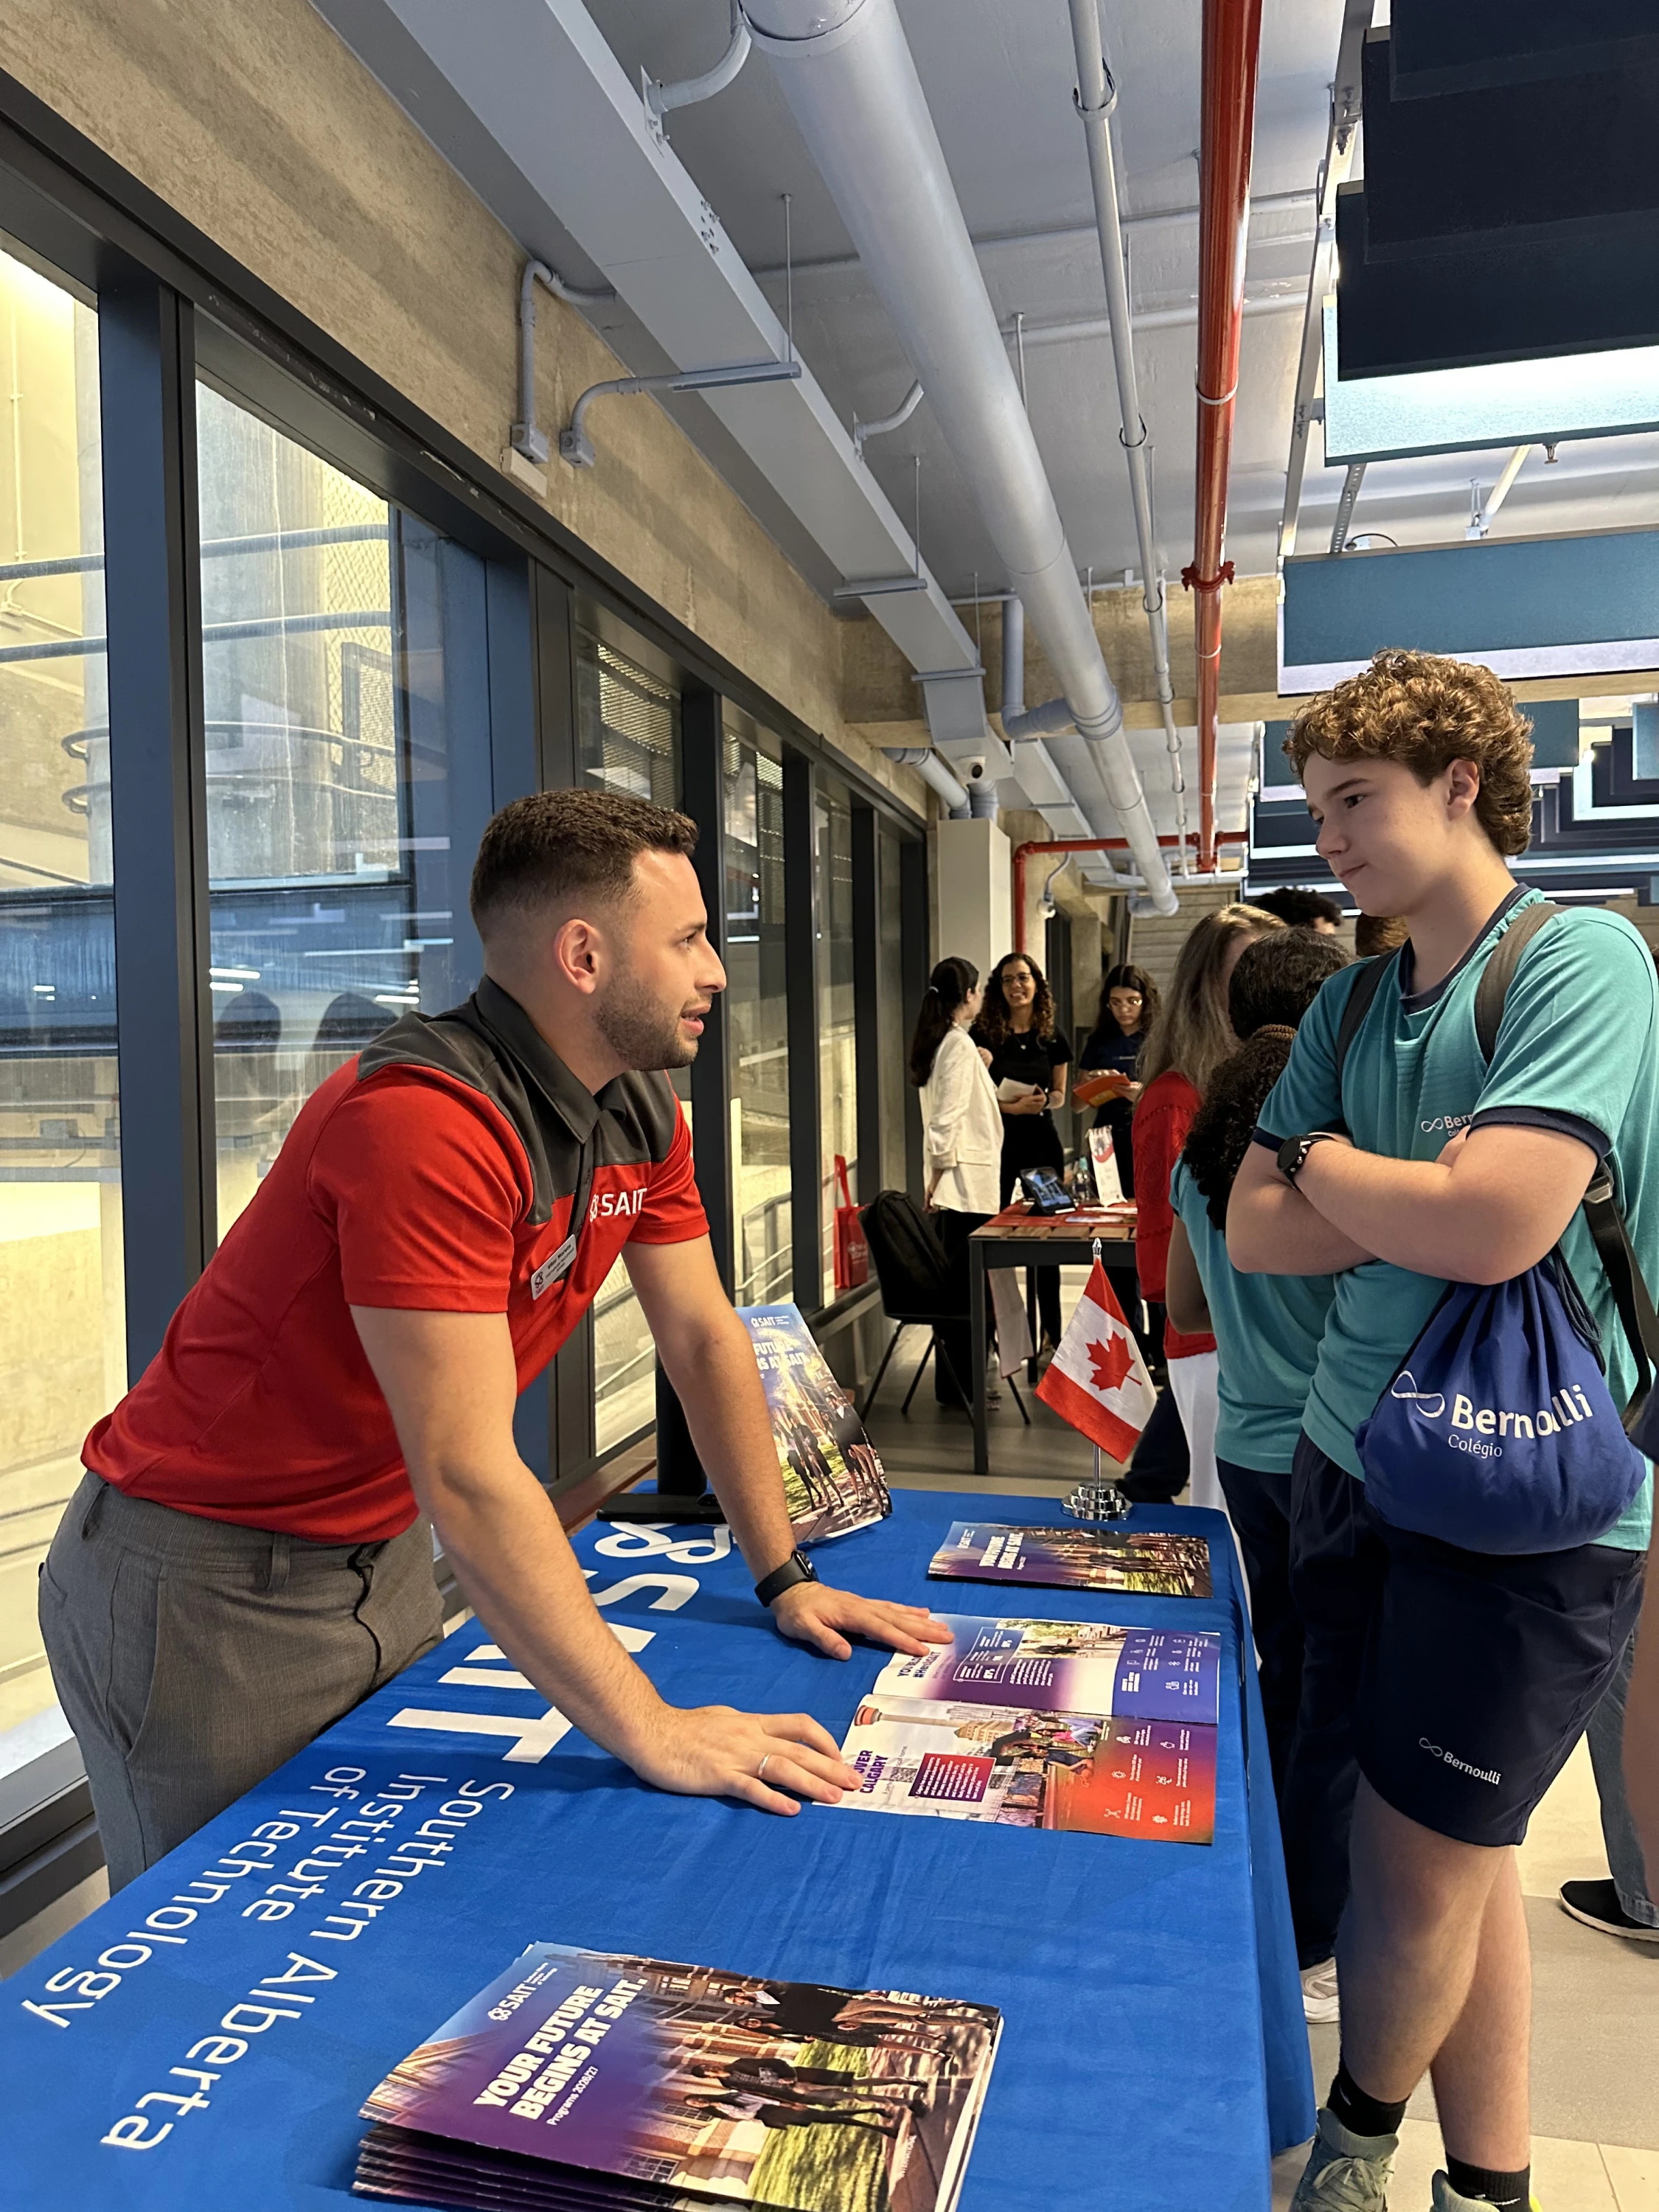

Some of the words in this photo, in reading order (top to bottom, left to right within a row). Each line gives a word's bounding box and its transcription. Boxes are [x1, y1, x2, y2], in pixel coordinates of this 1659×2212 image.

[600, 1187, 648, 1217] SAIT
[759, 1316, 776, 1326] SAIT
[752, 1341, 794, 1356] FUTUE
[1448, 1434, 1502, 1459] Colégio
[310, 1767, 366, 1800] of
[859, 1755, 888, 1794] CALGARY
[1443, 1751, 1502, 1785] Bernoulli
[242, 1774, 448, 1921] Institute
[310, 1780, 515, 1941] Southern
[21, 1807, 339, 2028] Technology
[498, 1983, 537, 2009] SAIT
[100, 1952, 338, 2150] Alberta
[473, 2053, 545, 2107] YOUR
[524, 1986, 604, 2054] FUTURE
[509, 2043, 591, 2120] BEGINS
[574, 2017, 612, 2045] AT
[594, 1978, 648, 2019] SAIT.
[546, 2093, 580, 2125] Programs
[572, 2065, 599, 2094] 2026/27
